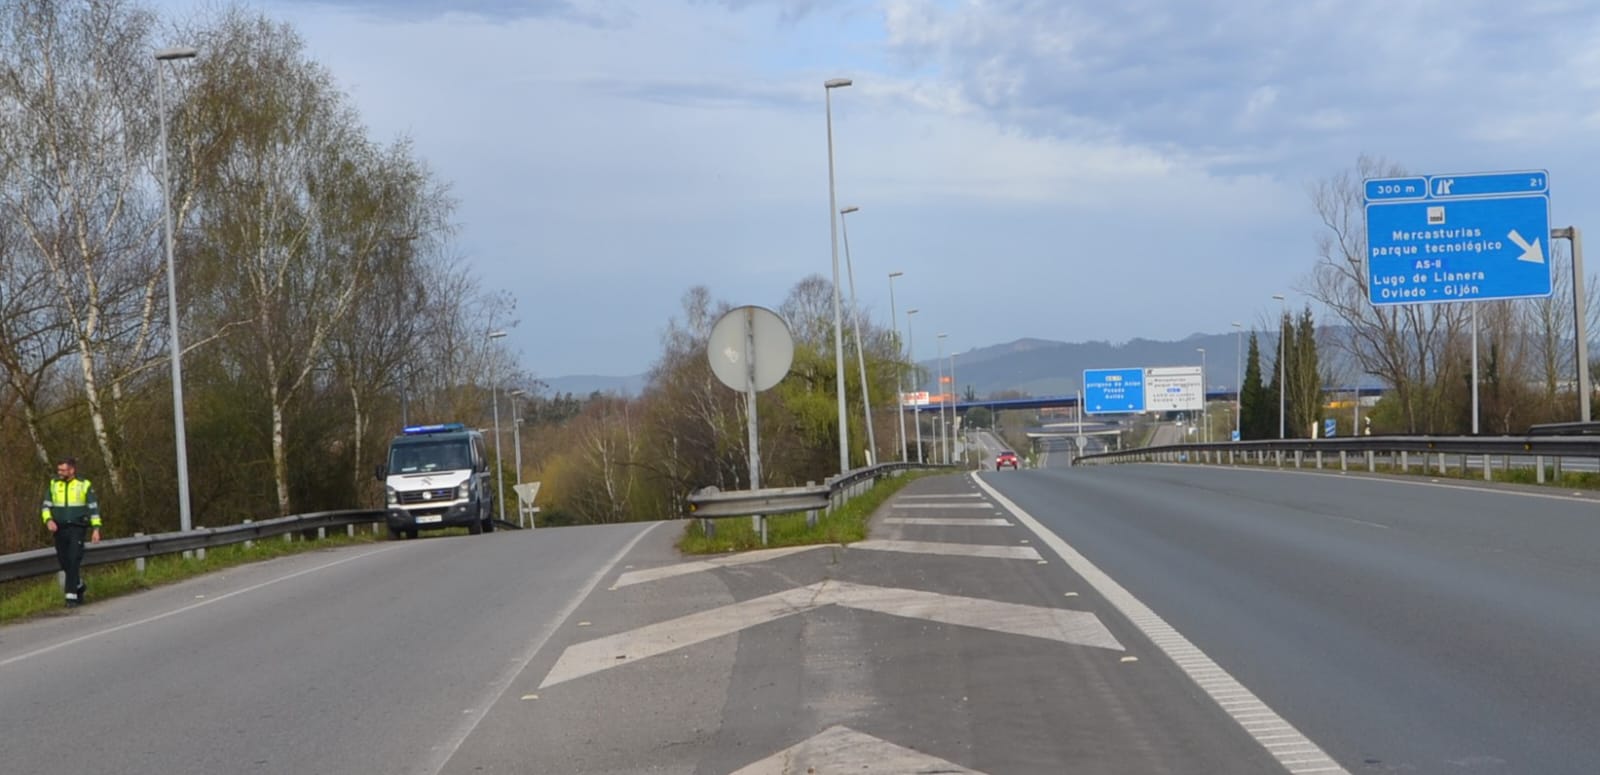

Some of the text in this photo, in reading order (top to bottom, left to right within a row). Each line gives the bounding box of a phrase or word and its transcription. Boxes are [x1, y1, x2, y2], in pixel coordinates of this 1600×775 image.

[1530, 178, 1543, 187] 21
[1377, 185, 1401, 194] 300
[1392, 228, 1482, 241] Mercasturias
[1373, 241, 1503, 257] parque tecnológico
[1374, 271, 1485, 286] Lugo de Llanera
[1381, 287, 1427, 298] Oviedo
[1444, 284, 1479, 297] Gijón
